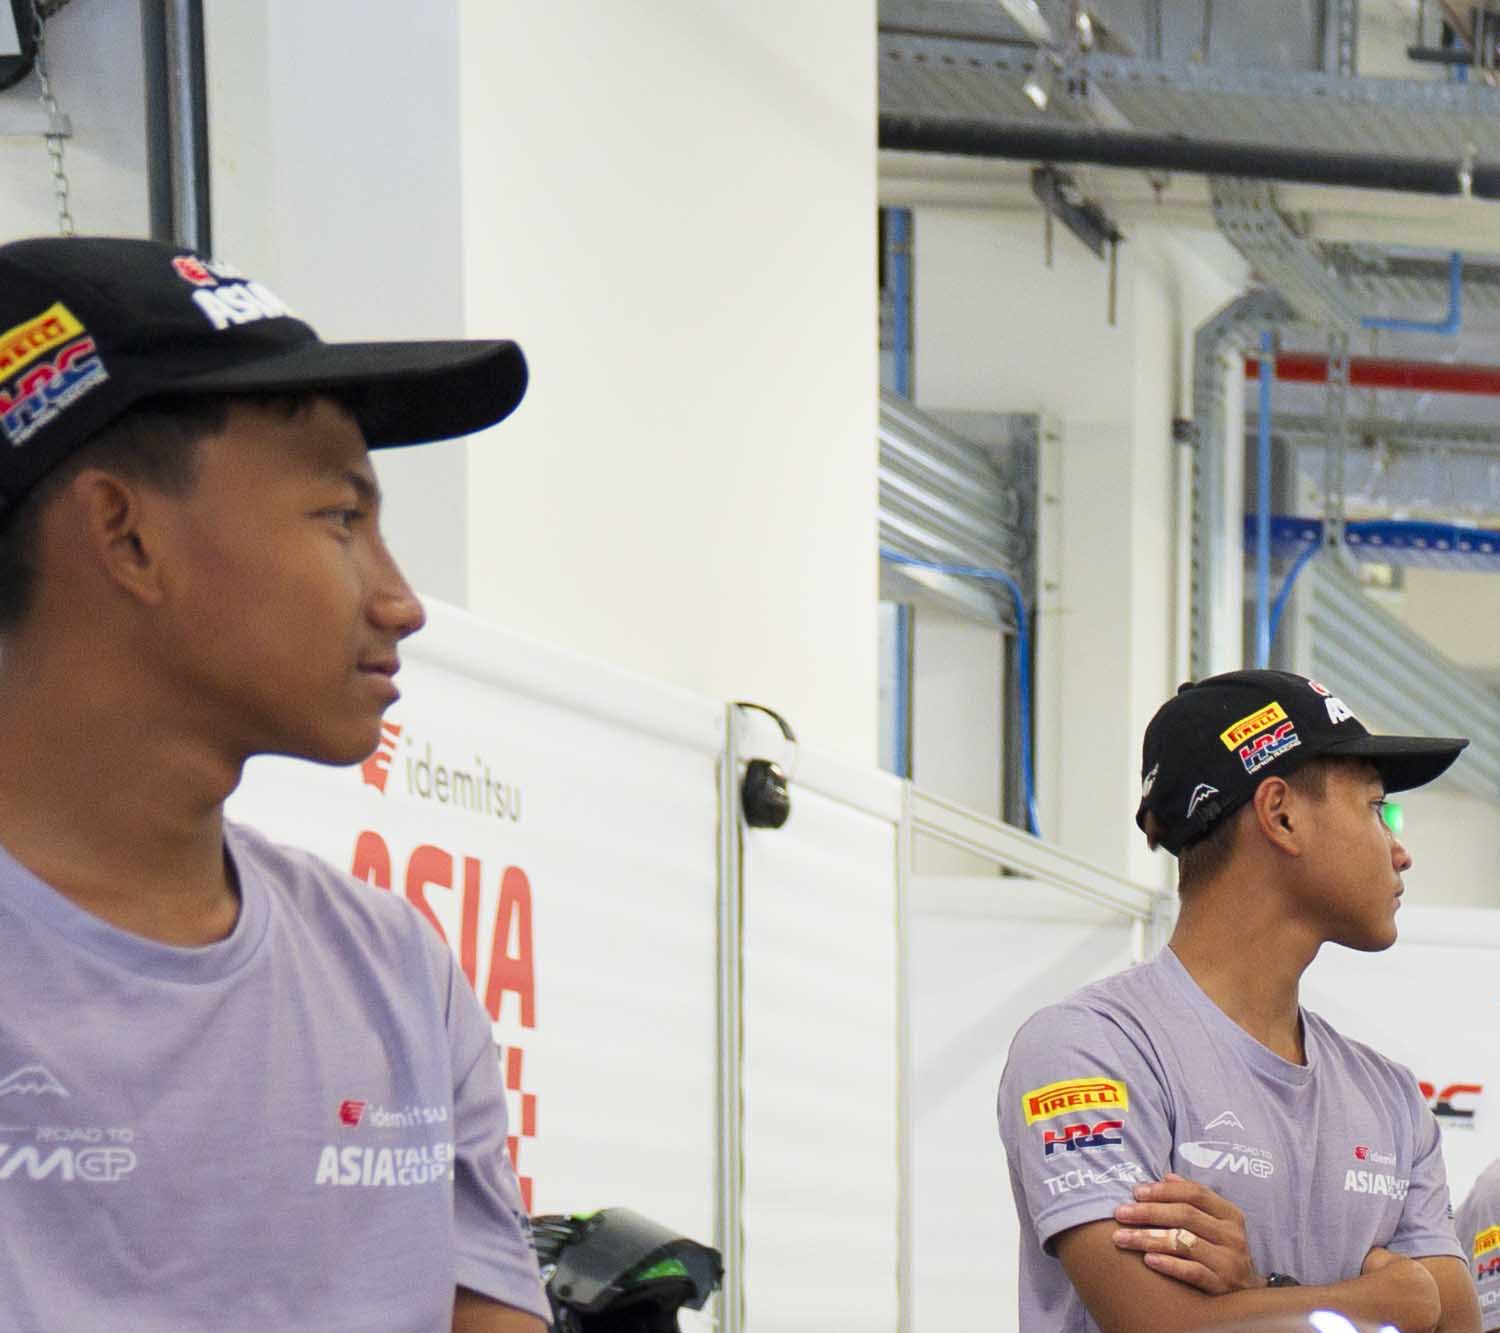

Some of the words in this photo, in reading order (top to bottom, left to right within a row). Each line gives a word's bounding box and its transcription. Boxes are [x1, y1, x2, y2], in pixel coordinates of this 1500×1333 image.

[1228, 707, 1281, 745] PIRELLI
[1240, 722, 1297, 770] HRC
[406, 734, 526, 824] idemitsu
[368, 1105, 448, 1126] idemitsu
[1028, 1083, 1123, 1116] PIRELLI
[1044, 1120, 1126, 1156] HRC
[315, 1146, 395, 1187] ASIA
[394, 1146, 455, 1166] TALE
[397, 1165, 444, 1187] CUP
